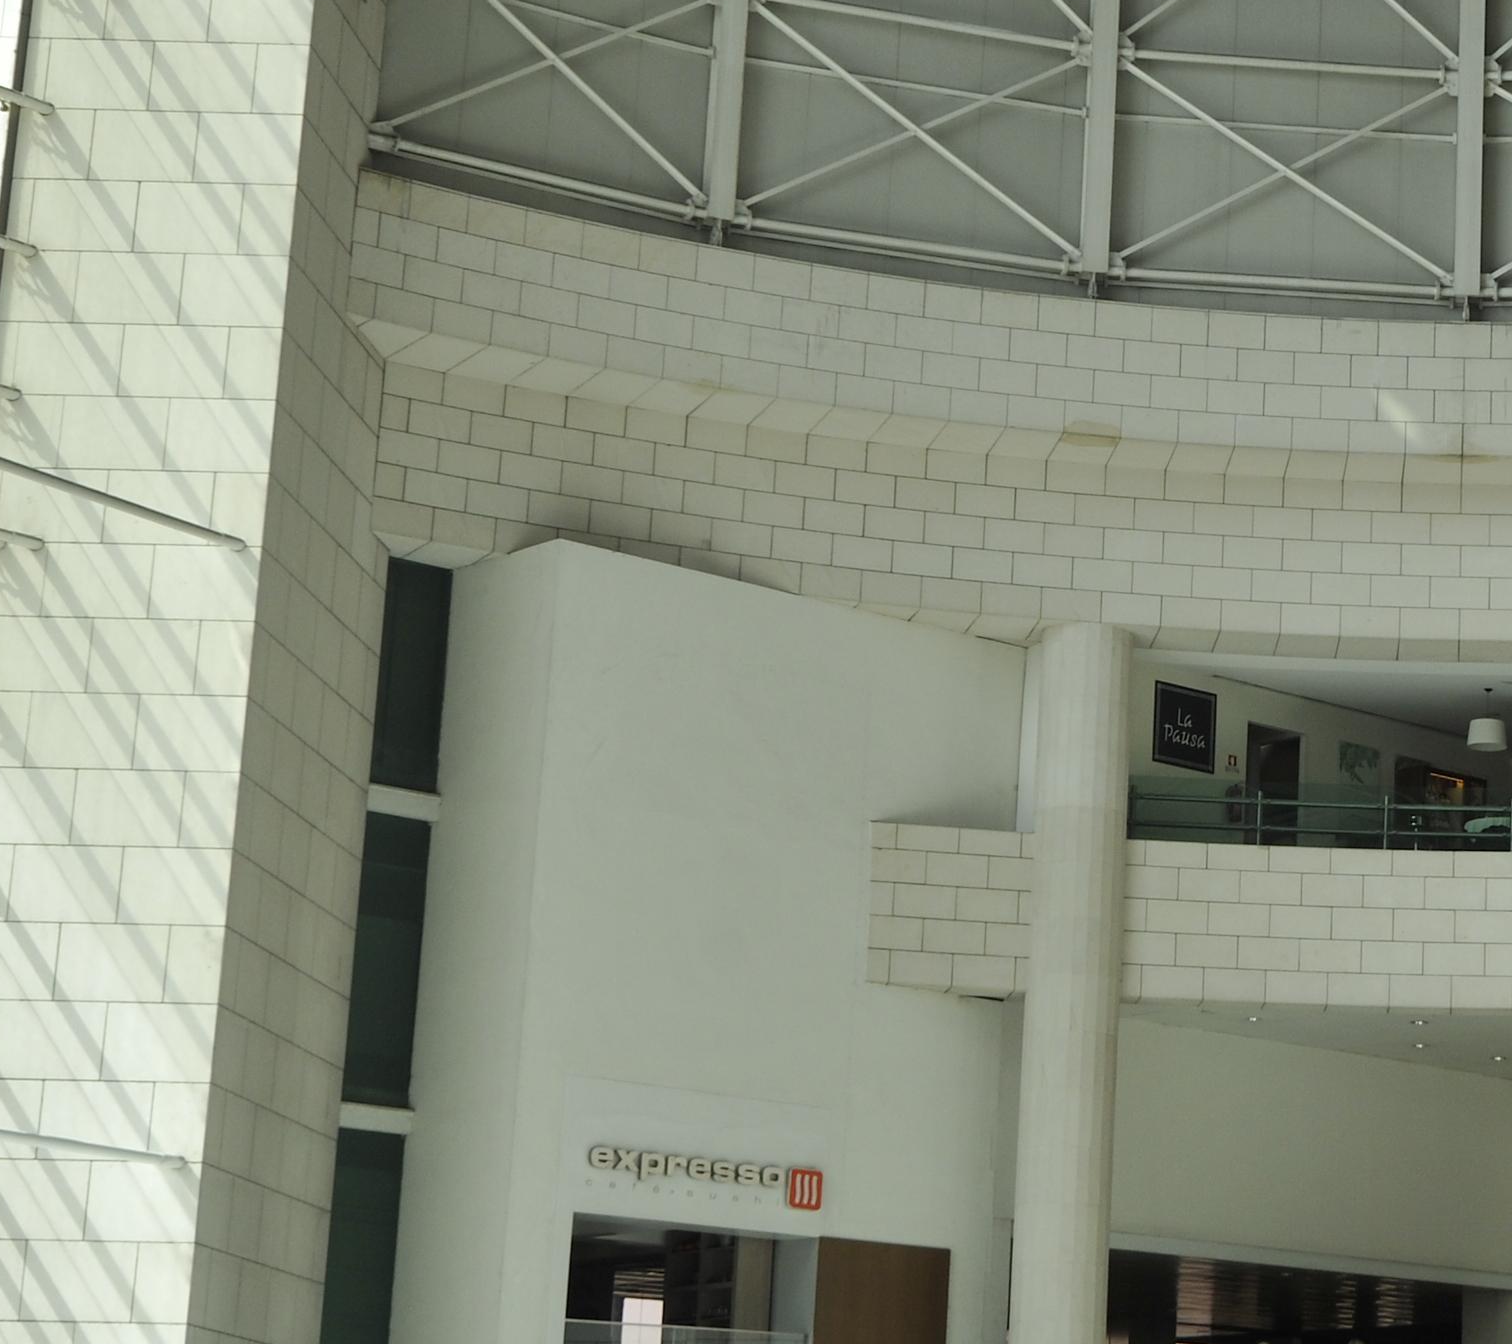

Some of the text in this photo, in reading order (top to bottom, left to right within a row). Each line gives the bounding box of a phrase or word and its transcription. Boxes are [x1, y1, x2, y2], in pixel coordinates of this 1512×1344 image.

[1177, 707, 1193, 728] La
[1163, 723, 1206, 749] Pausa
[589, 1145, 786, 1187] expresso
